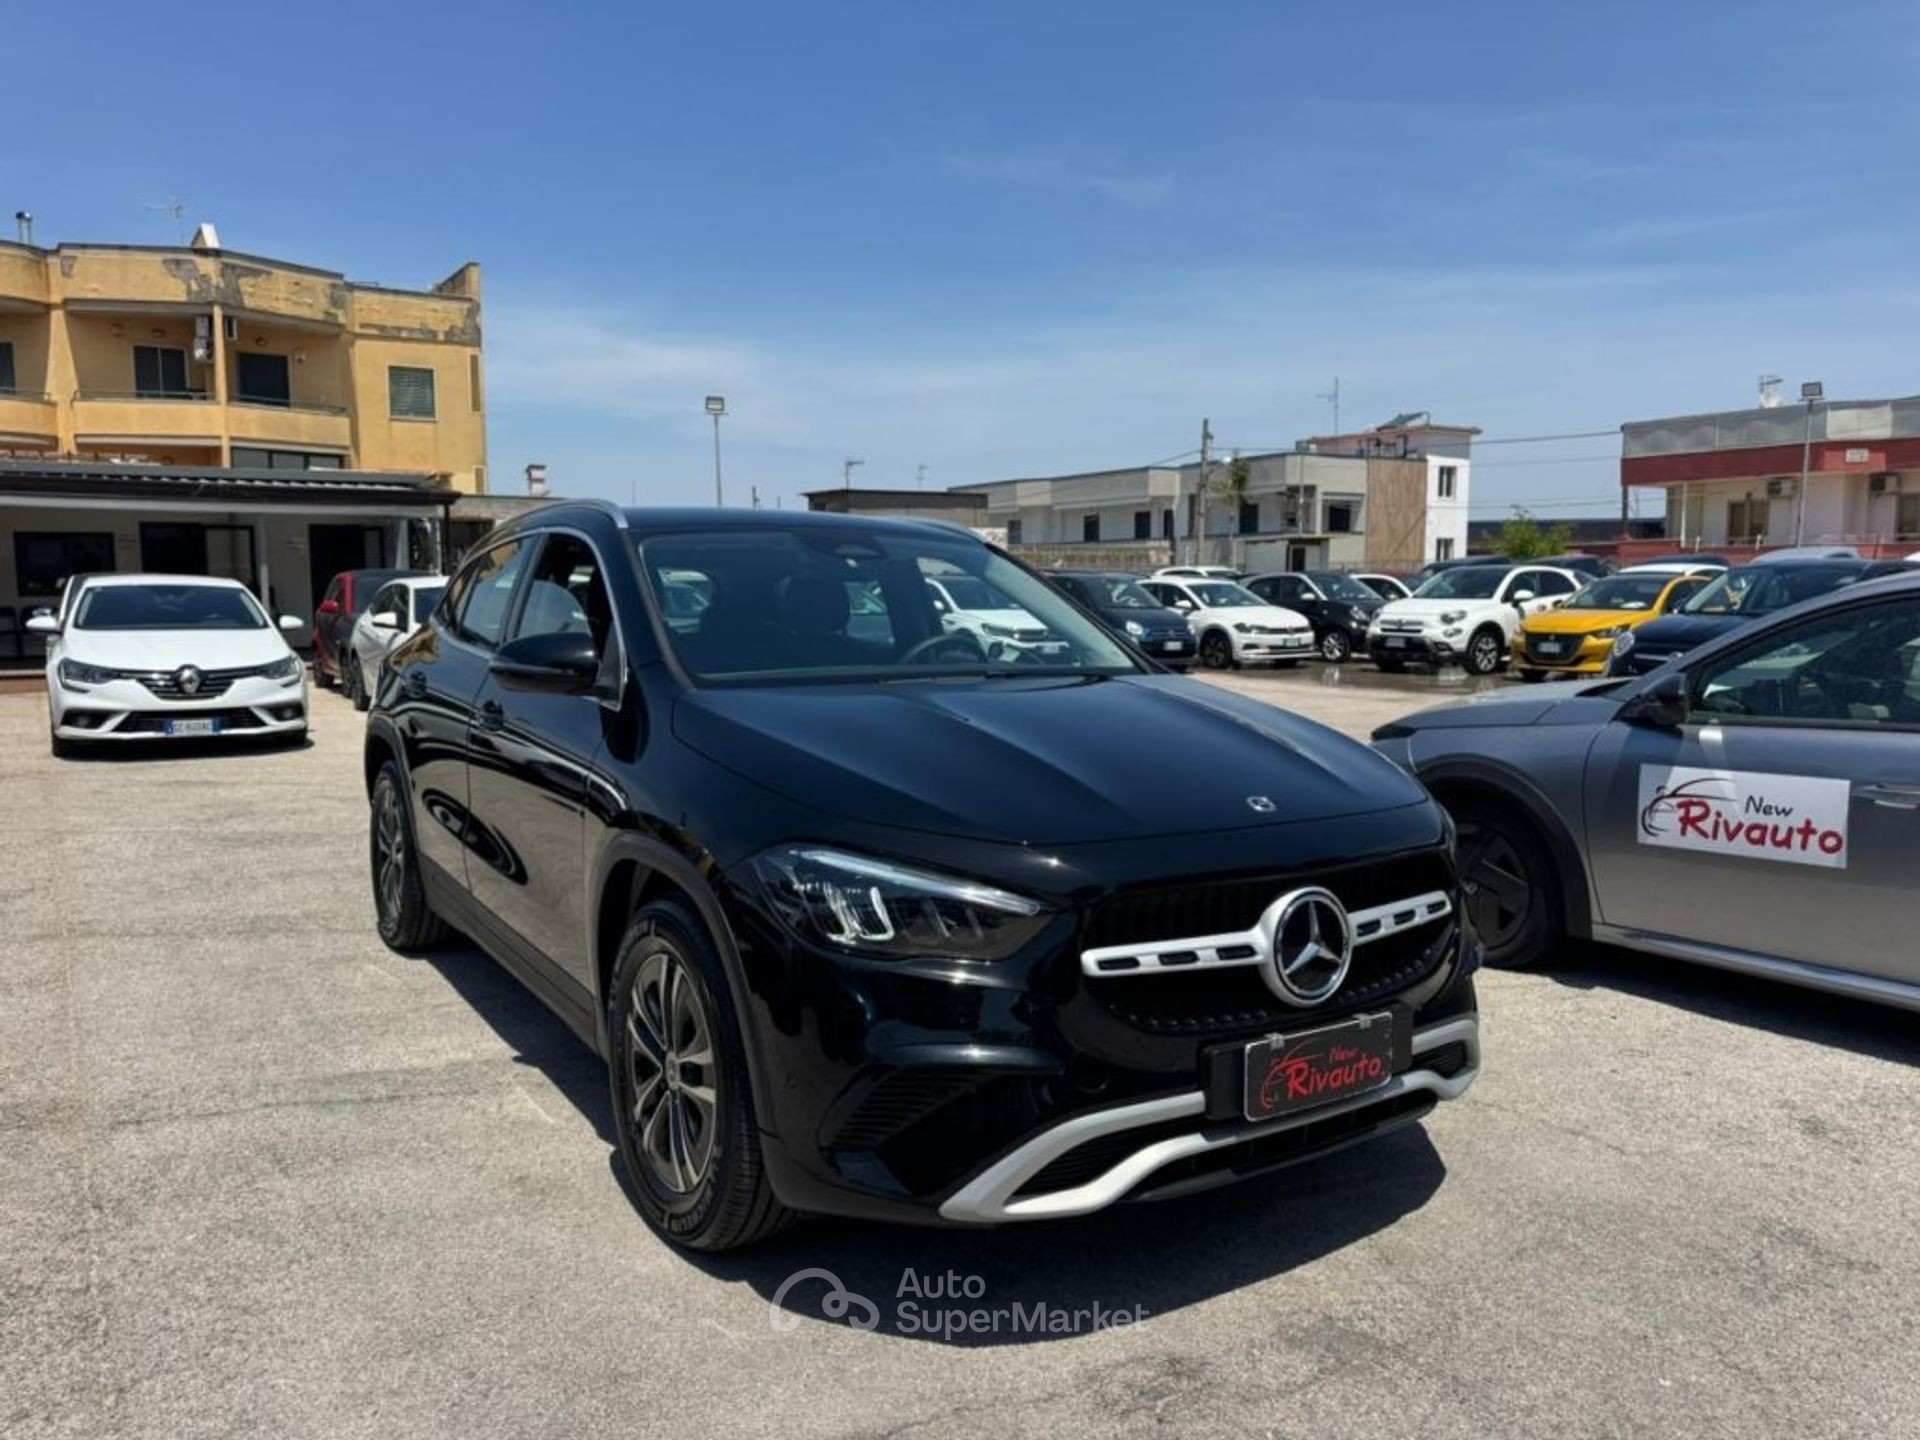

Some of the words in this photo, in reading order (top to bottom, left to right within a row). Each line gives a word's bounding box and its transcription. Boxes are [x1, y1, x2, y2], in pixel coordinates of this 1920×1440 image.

[1744, 795, 1794, 817] New
[1676, 799, 1843, 854] Rivauto
[1329, 1046, 1361, 1063] New
[1286, 1054, 1382, 1099] Rivauto
